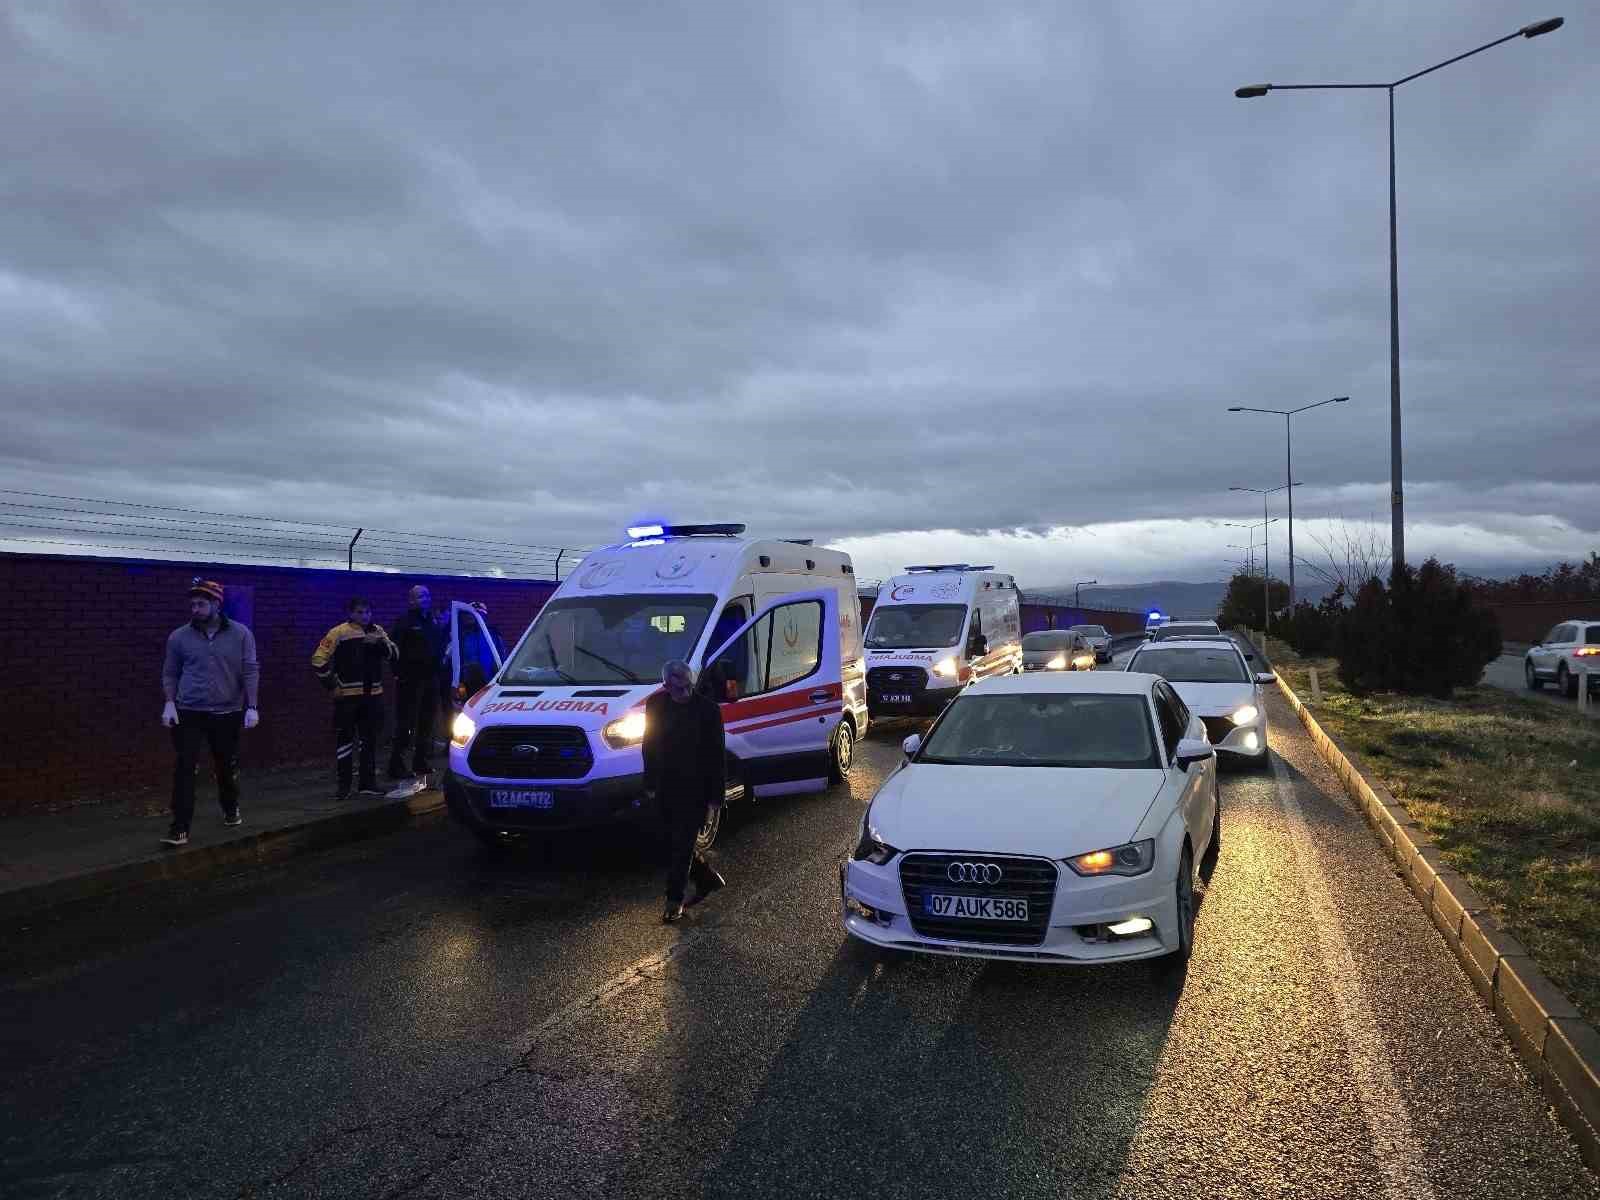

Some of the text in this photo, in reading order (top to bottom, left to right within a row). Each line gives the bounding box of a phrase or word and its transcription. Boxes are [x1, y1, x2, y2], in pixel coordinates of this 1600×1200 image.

[932, 896, 1027, 919] 07 AUK 586
